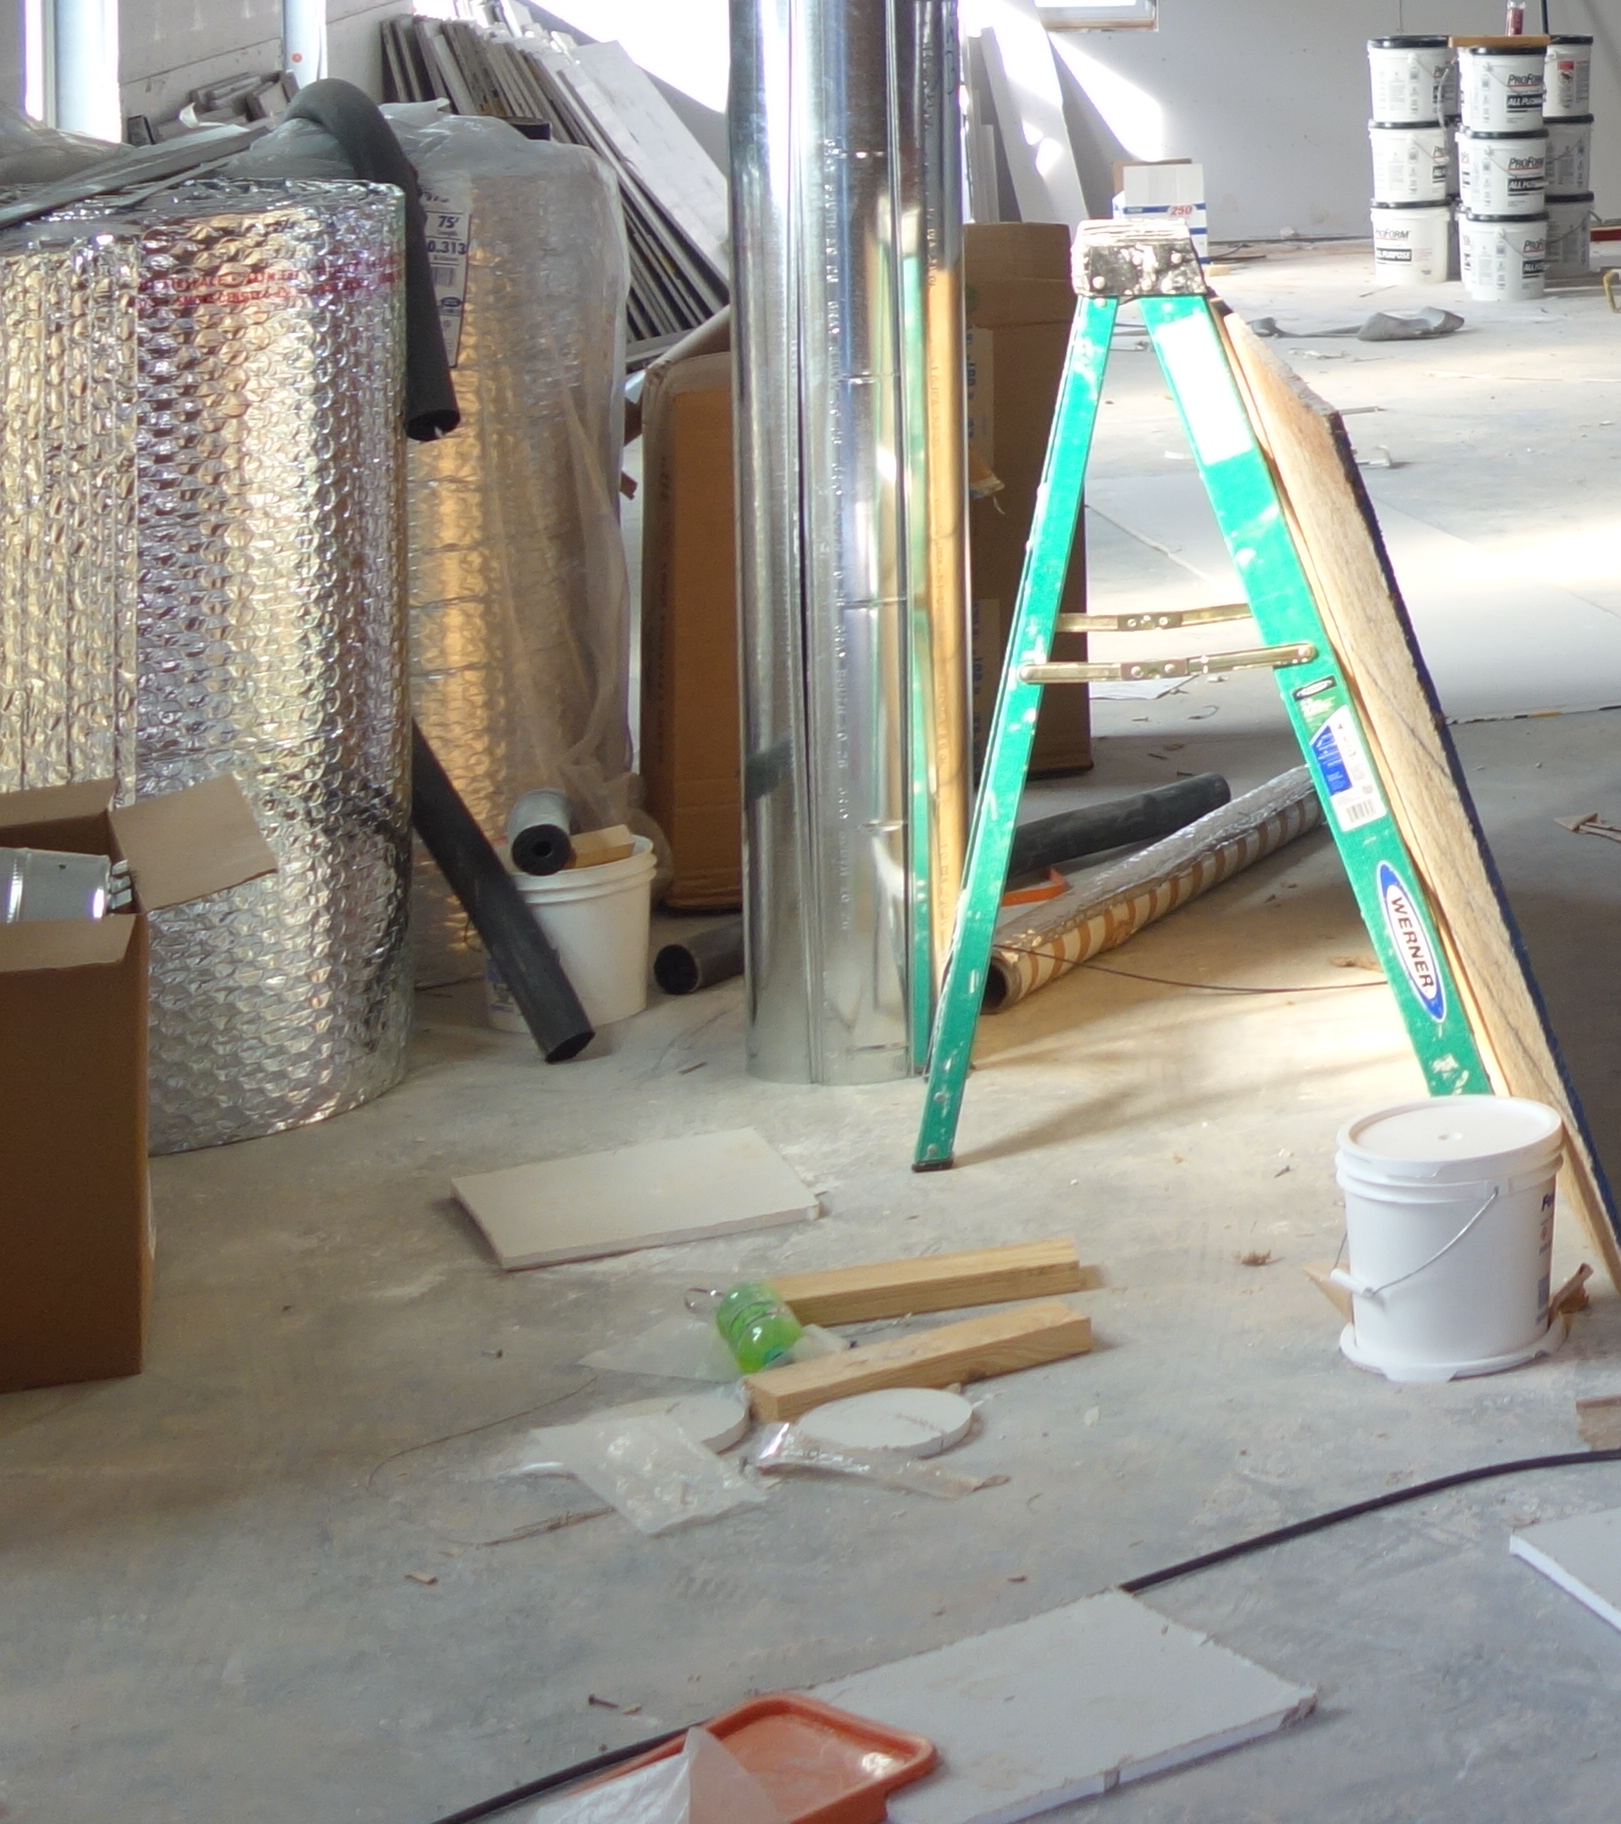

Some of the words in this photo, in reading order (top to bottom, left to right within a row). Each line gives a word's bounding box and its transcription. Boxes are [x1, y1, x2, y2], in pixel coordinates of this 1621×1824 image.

[1170, 204, 1193, 217] 250
[427, 240, 468, 255] 0.313
[1391, 896, 1435, 989] WERNER
